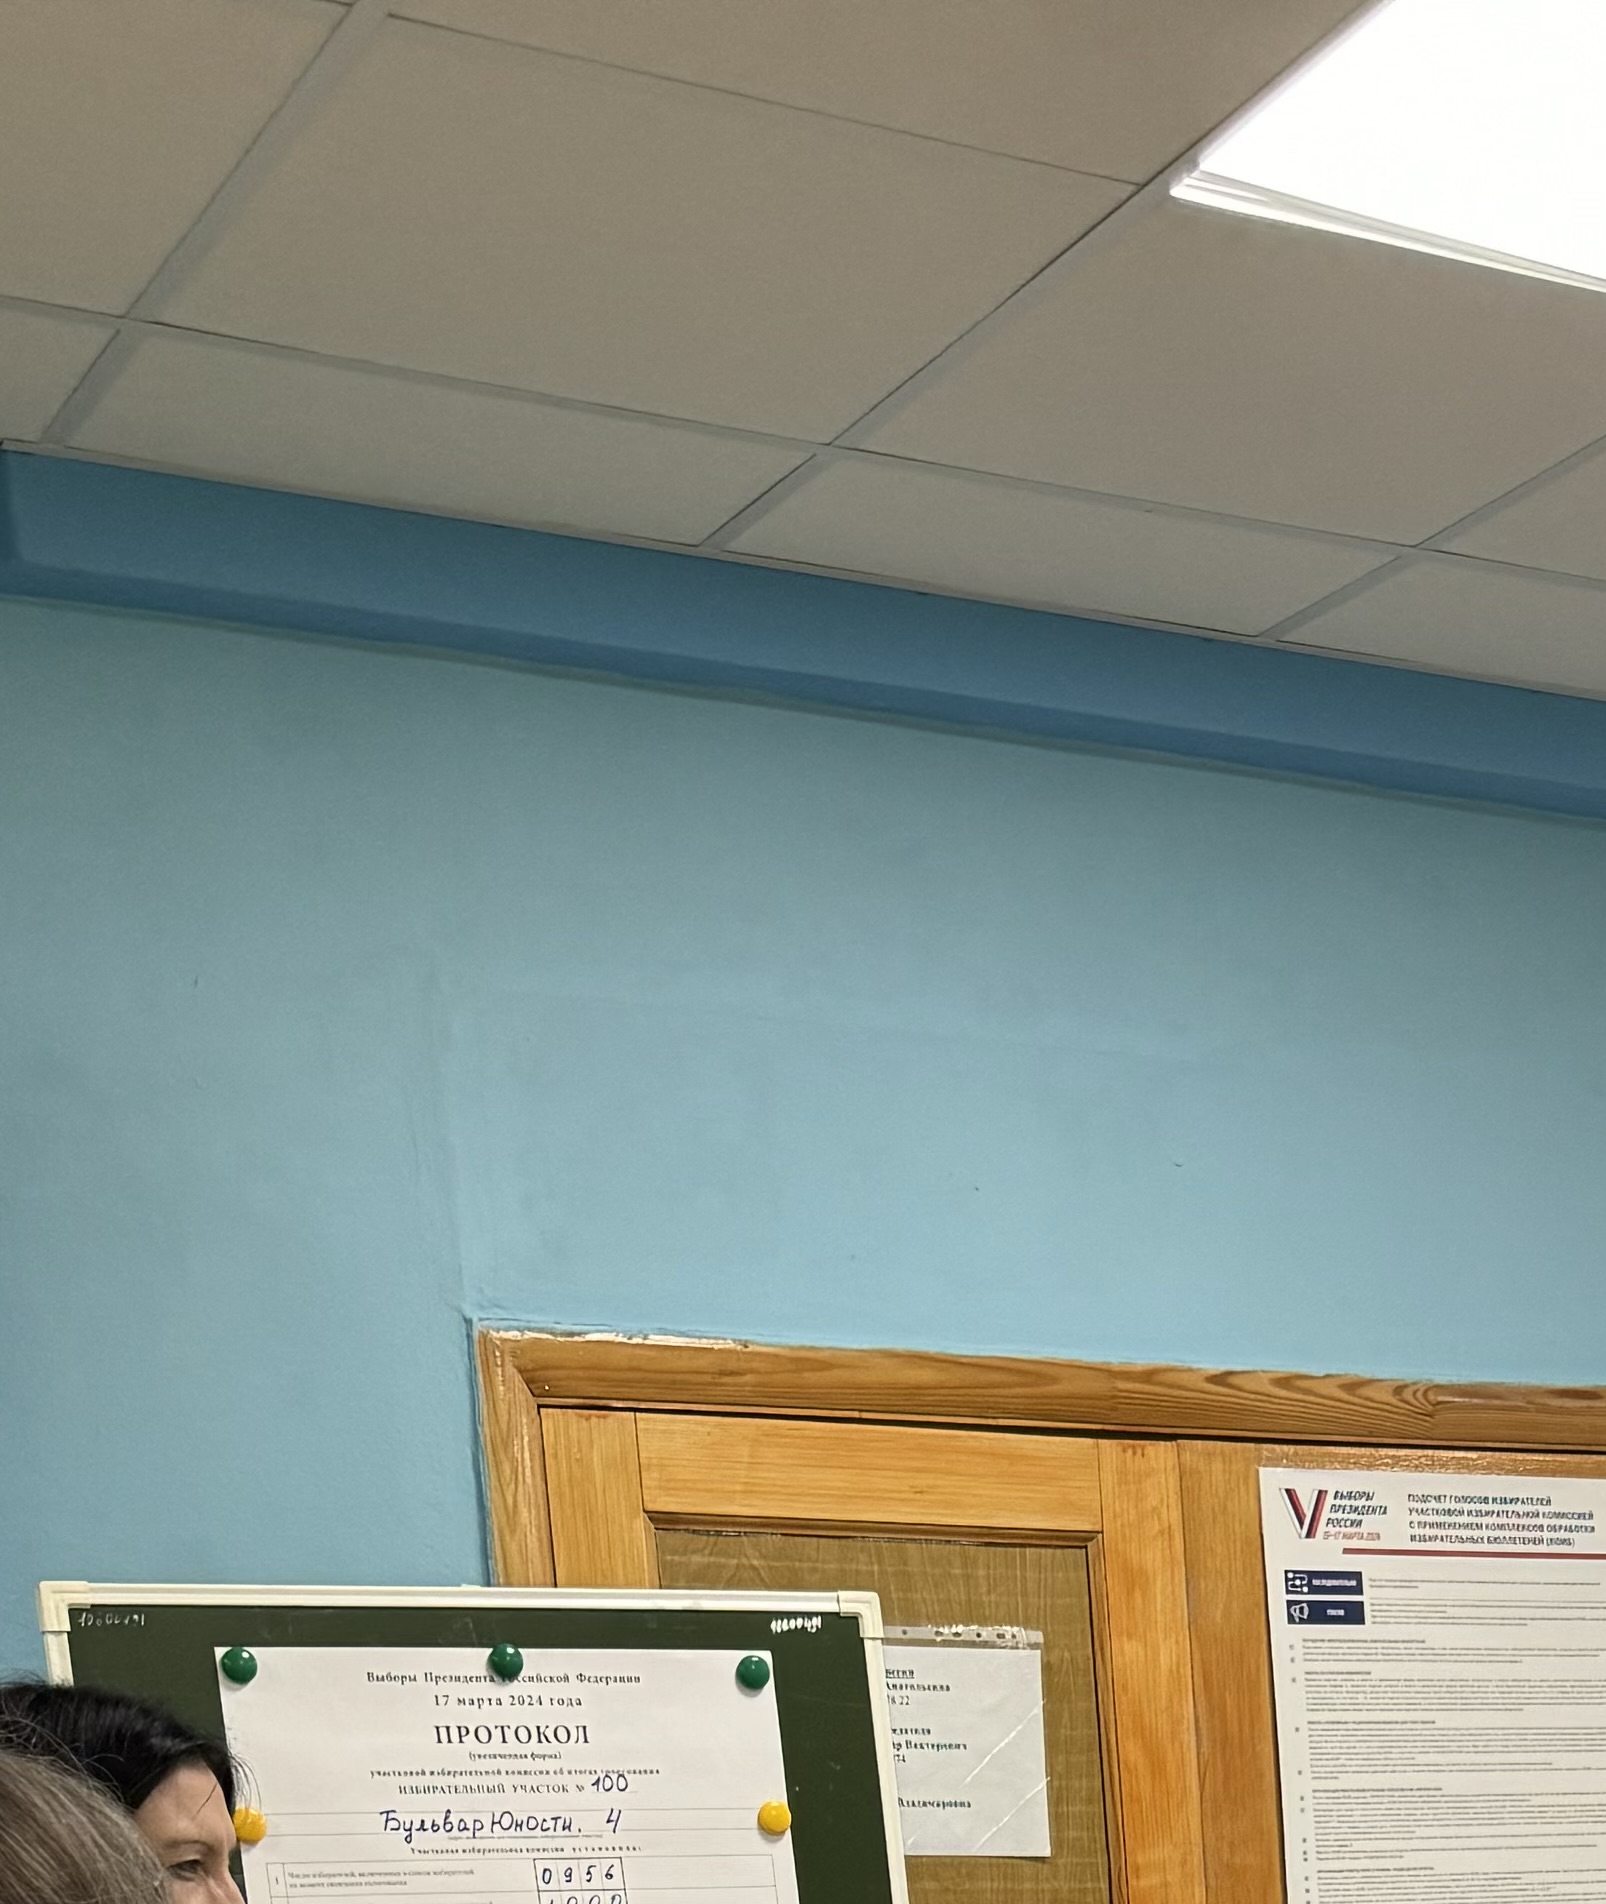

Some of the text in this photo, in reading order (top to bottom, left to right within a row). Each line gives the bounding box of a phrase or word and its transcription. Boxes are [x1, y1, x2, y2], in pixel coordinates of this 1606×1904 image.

[1333, 1490, 1375, 1502] ВЫБОРЫ
[1330, 1504, 1388, 1516] ПРЕЗИДЕНТА
[1326, 1517, 1363, 1529] РОССИИ
[1409, 1521, 1415, 1530] С
[366, 1672, 417, 1686] Выборы
[424, 1672, 496, 1686] Президента
[576, 1672, 642, 1686] Федерации
[433, 1694, 583, 1710] 17 марта 2024 года
[434, 1725, 591, 1744] ПРОТОКОЛ
[398, 1782, 585, 1795] ИЗБИРАТЕЛЬНЫЙ УЧАСТОК №
[591, 1773, 629, 1793] 100
[380, 1809, 485, 1844] Бульвар
[606, 1808, 622, 1835] 4
